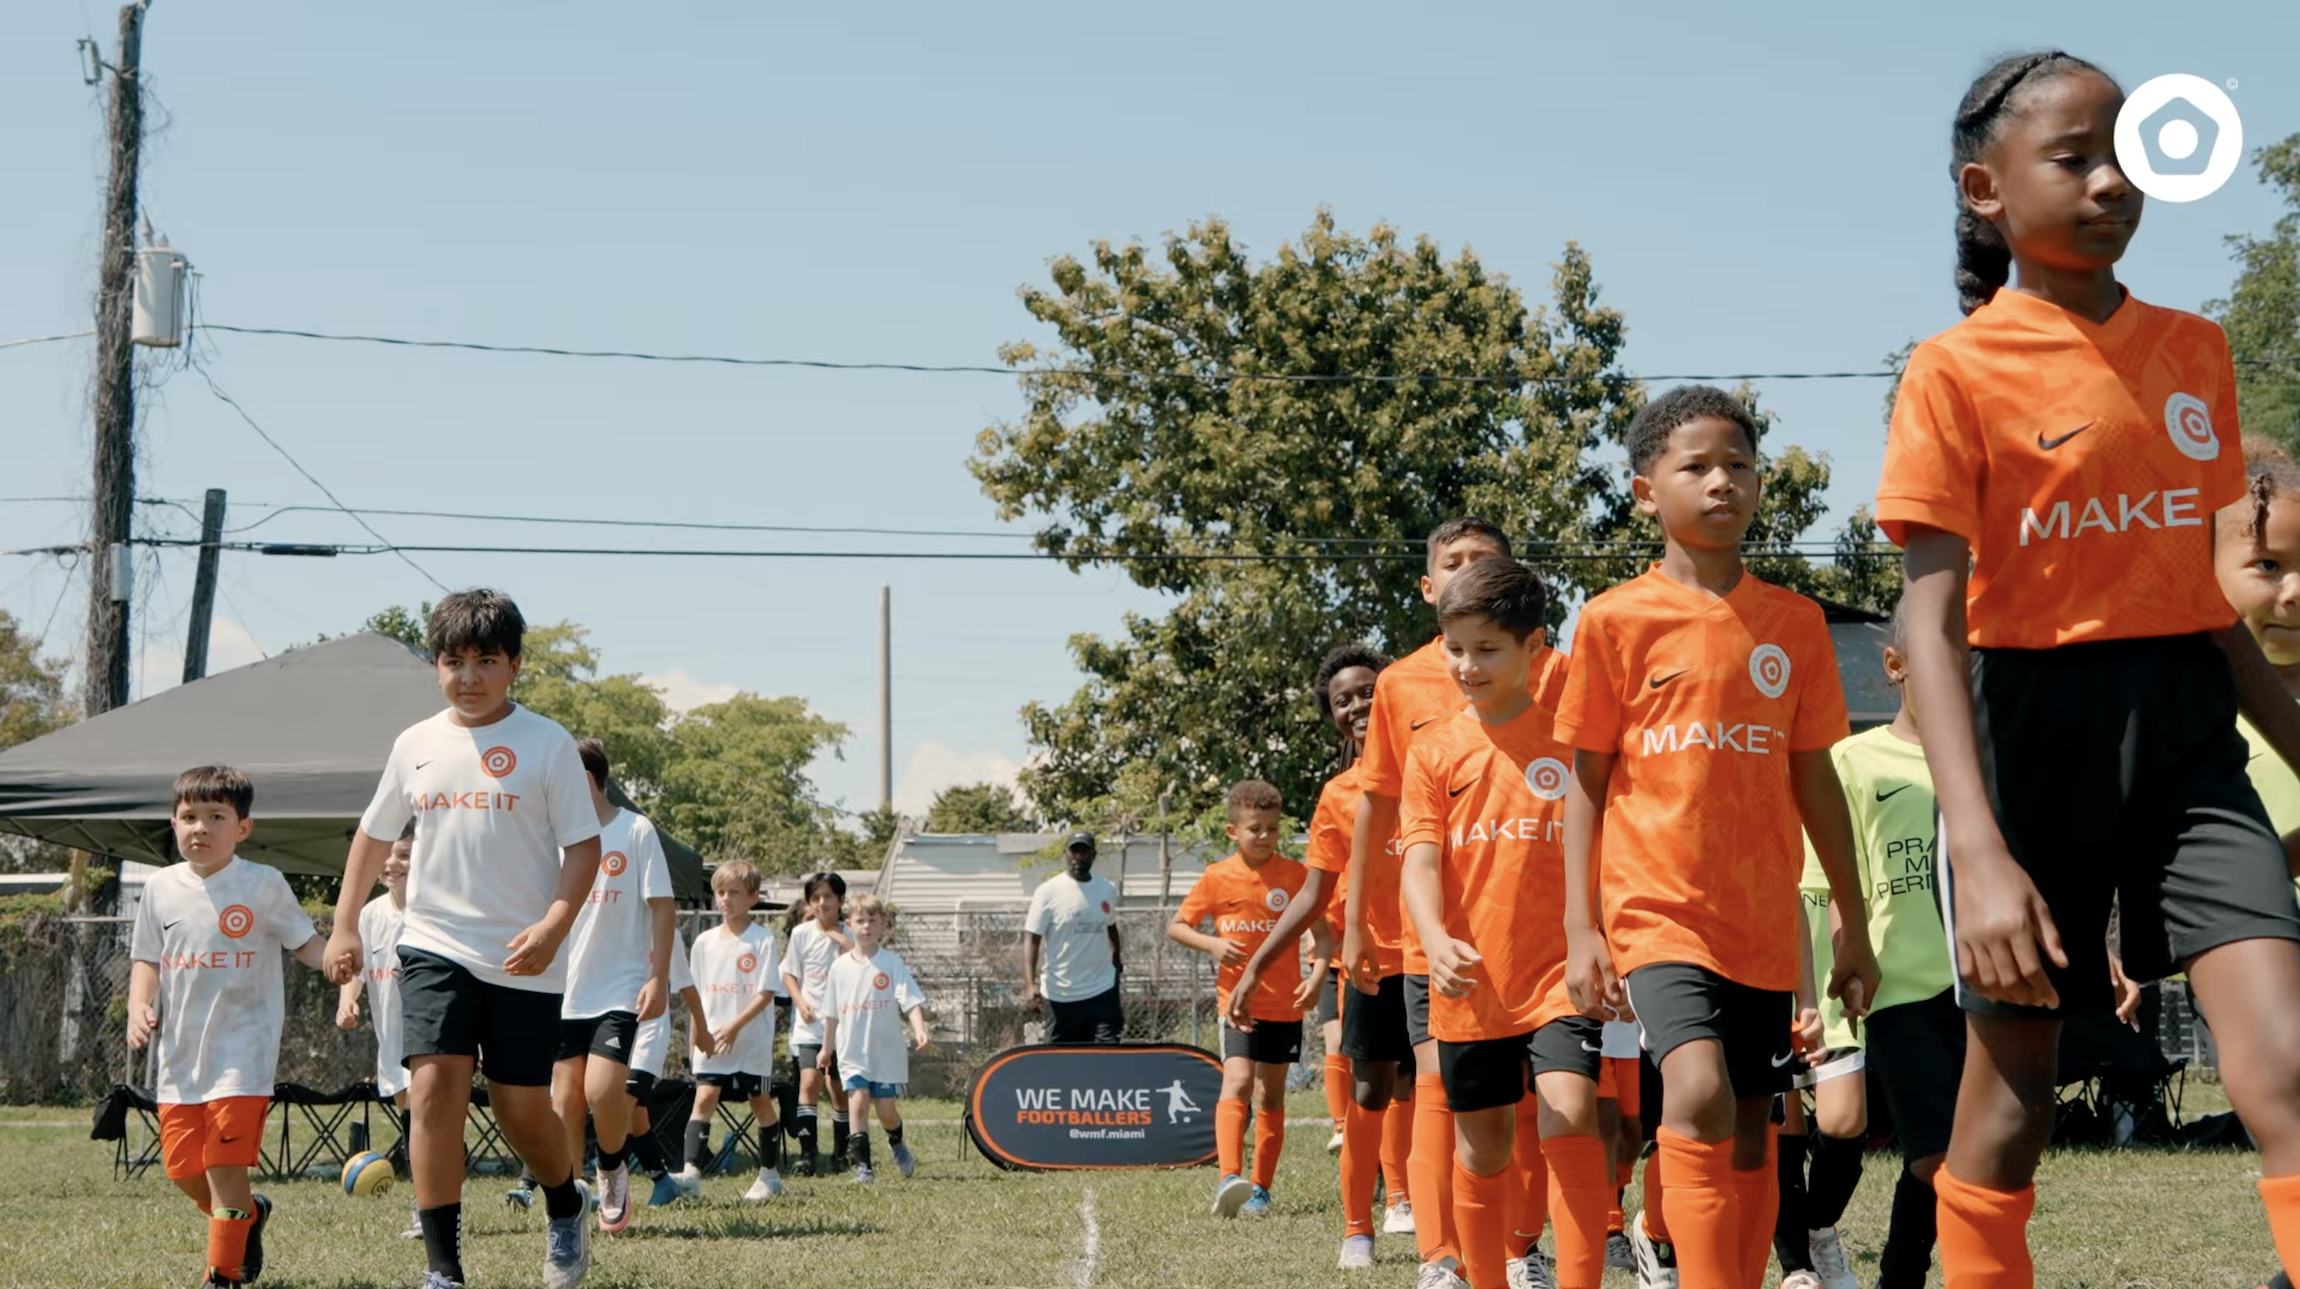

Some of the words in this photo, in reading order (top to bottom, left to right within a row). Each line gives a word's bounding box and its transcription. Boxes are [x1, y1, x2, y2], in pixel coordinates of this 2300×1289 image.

[2018, 487, 2204, 548] MAKE
[1641, 721, 1772, 758] MAKE
[496, 792, 521, 811] IT
[604, 889, 623, 904] IT
[234, 951, 256, 969] IT
[743, 983, 755, 994] IT
[1015, 1088, 1062, 1110] WE
[1070, 1088, 1152, 1111] MAKE
[1016, 1110, 1153, 1126] FOOTBALLERS
[1068, 1128, 1146, 1139] @wmf.miami
